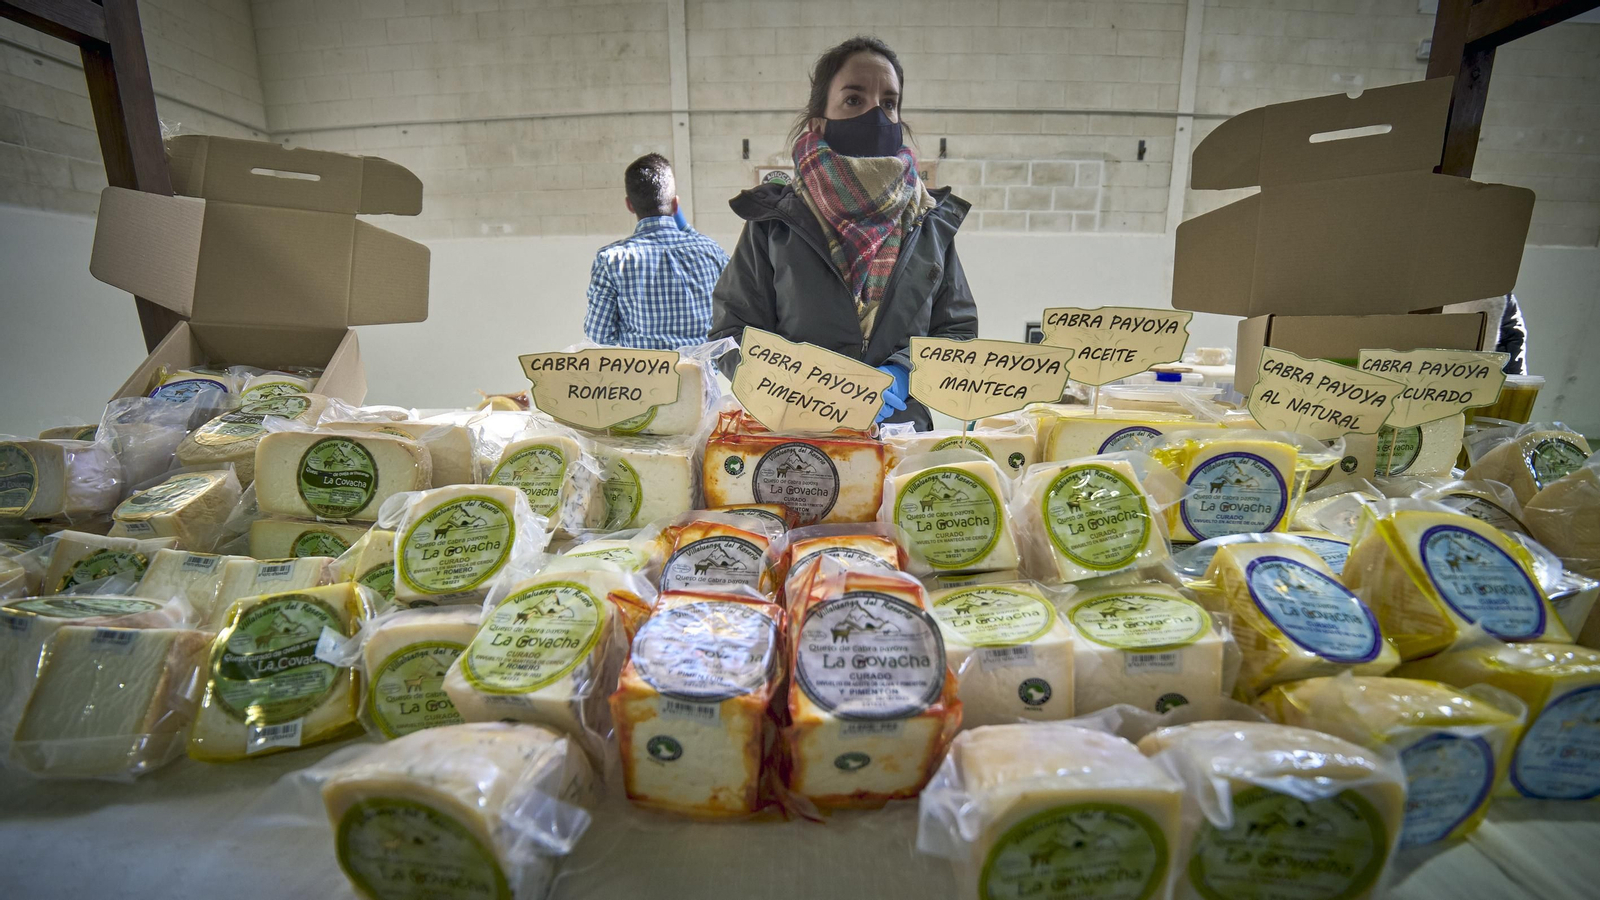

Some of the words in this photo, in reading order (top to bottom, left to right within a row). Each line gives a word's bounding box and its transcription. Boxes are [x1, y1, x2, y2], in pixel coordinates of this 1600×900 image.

[1047, 313, 1102, 328] CABRA
[1109, 315, 1178, 334] PAYOYA
[920, 346, 976, 364] CABRA
[984, 352, 1060, 375] PAYOYA
[1078, 347, 1138, 362] ACEITE
[531, 356, 589, 371] CABRA
[599, 356, 670, 375] PAYOYA
[1362, 358, 1412, 374] CABRA
[1419, 360, 1490, 379] PAYOYA
[748, 345, 802, 374] CABRA
[807, 366, 877, 404] PAYOYA
[939, 376, 1027, 399] MANTECA
[1263, 359, 1314, 385] CABRA
[1317, 375, 1387, 407] PAYOYA
[568, 384, 642, 401] ROMERO
[757, 377, 848, 423] PIMENTÓN
[1260, 389, 1280, 405] AL
[1286, 397, 1361, 430] NATURAL
[323, 476, 333, 485] La
[335, 477, 367, 489] Covacha
[770, 485, 783, 494] La
[1200, 501, 1215, 511] La
[917, 521, 932, 532] La
[1069, 523, 1085, 535] La
[1090, 528, 1116, 539] CURADO
[422, 549, 440, 560] La
[686, 543, 721, 558] Villaluenga
[724, 541, 734, 549] del
[737, 545, 759, 561] Rosario
[439, 557, 471, 566] CURADO
[443, 566, 473, 576] ROMERO
[675, 574, 696, 582] Queso
[514, 588, 556, 604] Villaluenga
[559, 586, 570, 594] del
[301, 603, 328, 621] Rosario
[816, 600, 859, 619] Villaluenga
[864, 598, 877, 606] del
[882, 600, 913, 620] Rosario
[952, 620, 971, 628] La
[490, 633, 513, 647] La
[433, 648, 445, 656] del
[839, 644, 851, 652] de
[506, 651, 542, 659] CURADO
[257, 661, 277, 672] La
[506, 663, 540, 671] ROMERO
[822, 654, 845, 669] La
[849, 673, 893, 681] CURADO
[400, 703, 420, 715] La
[424, 713, 460, 721] CURADO
